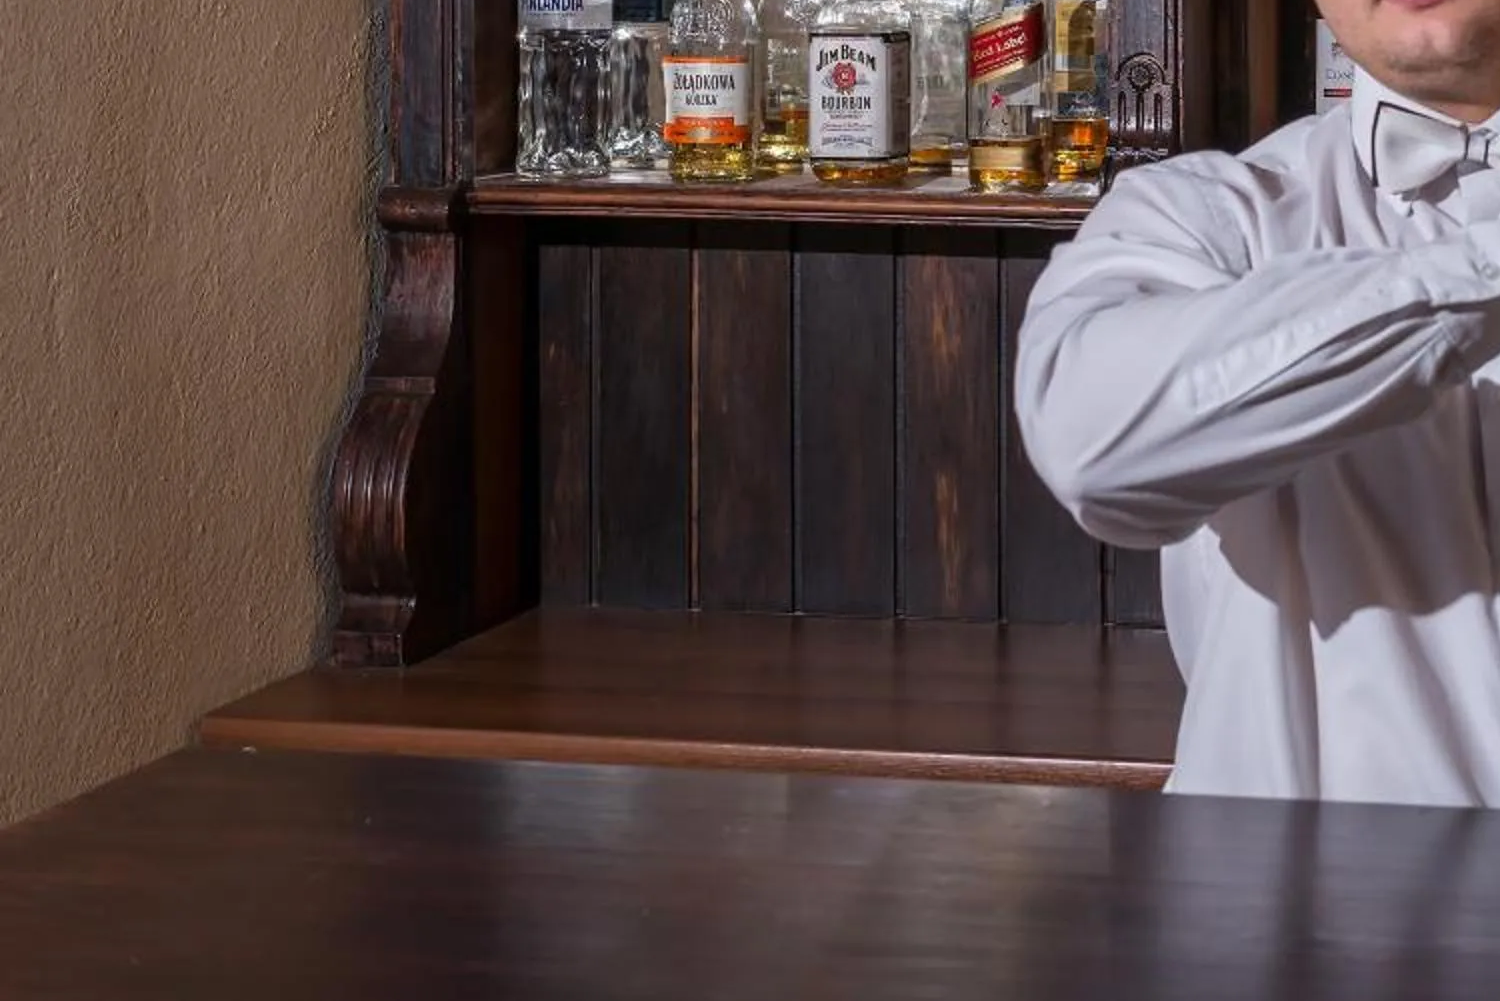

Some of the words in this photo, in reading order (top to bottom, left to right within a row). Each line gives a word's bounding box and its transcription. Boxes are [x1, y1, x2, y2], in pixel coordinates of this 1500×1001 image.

[816, 47, 840, 71] JIM
[842, 44, 877, 71] BEAM
[821, 95, 872, 110] BOURBON
